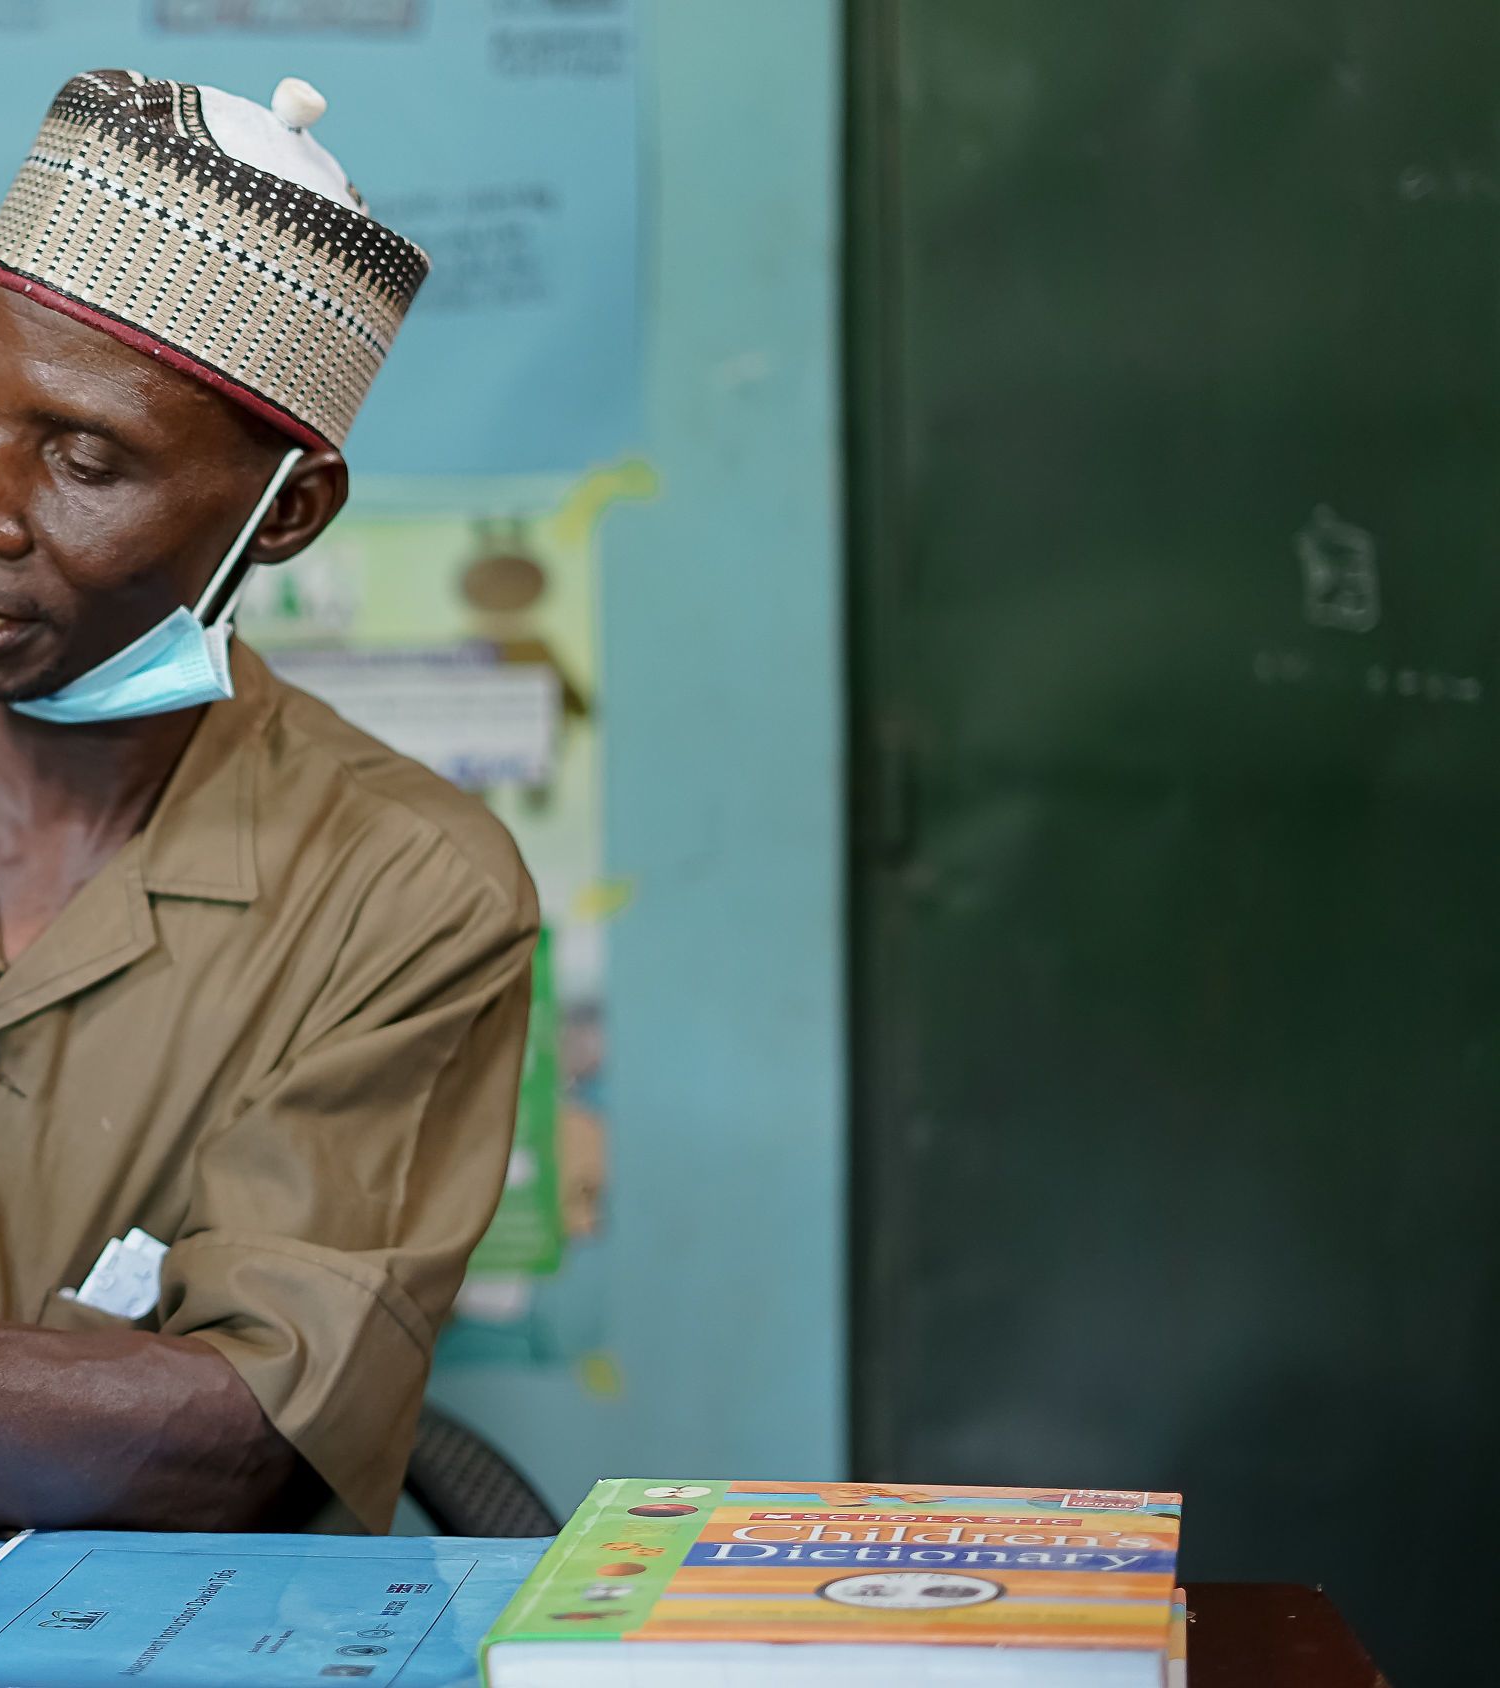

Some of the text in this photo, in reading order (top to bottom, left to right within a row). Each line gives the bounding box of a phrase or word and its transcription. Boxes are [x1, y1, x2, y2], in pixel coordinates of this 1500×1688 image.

[802, 1514, 1074, 1525] SCHOLASTIC
[732, 1524, 1151, 1549] Children's
[704, 1543, 1149, 1571] Dictionary
